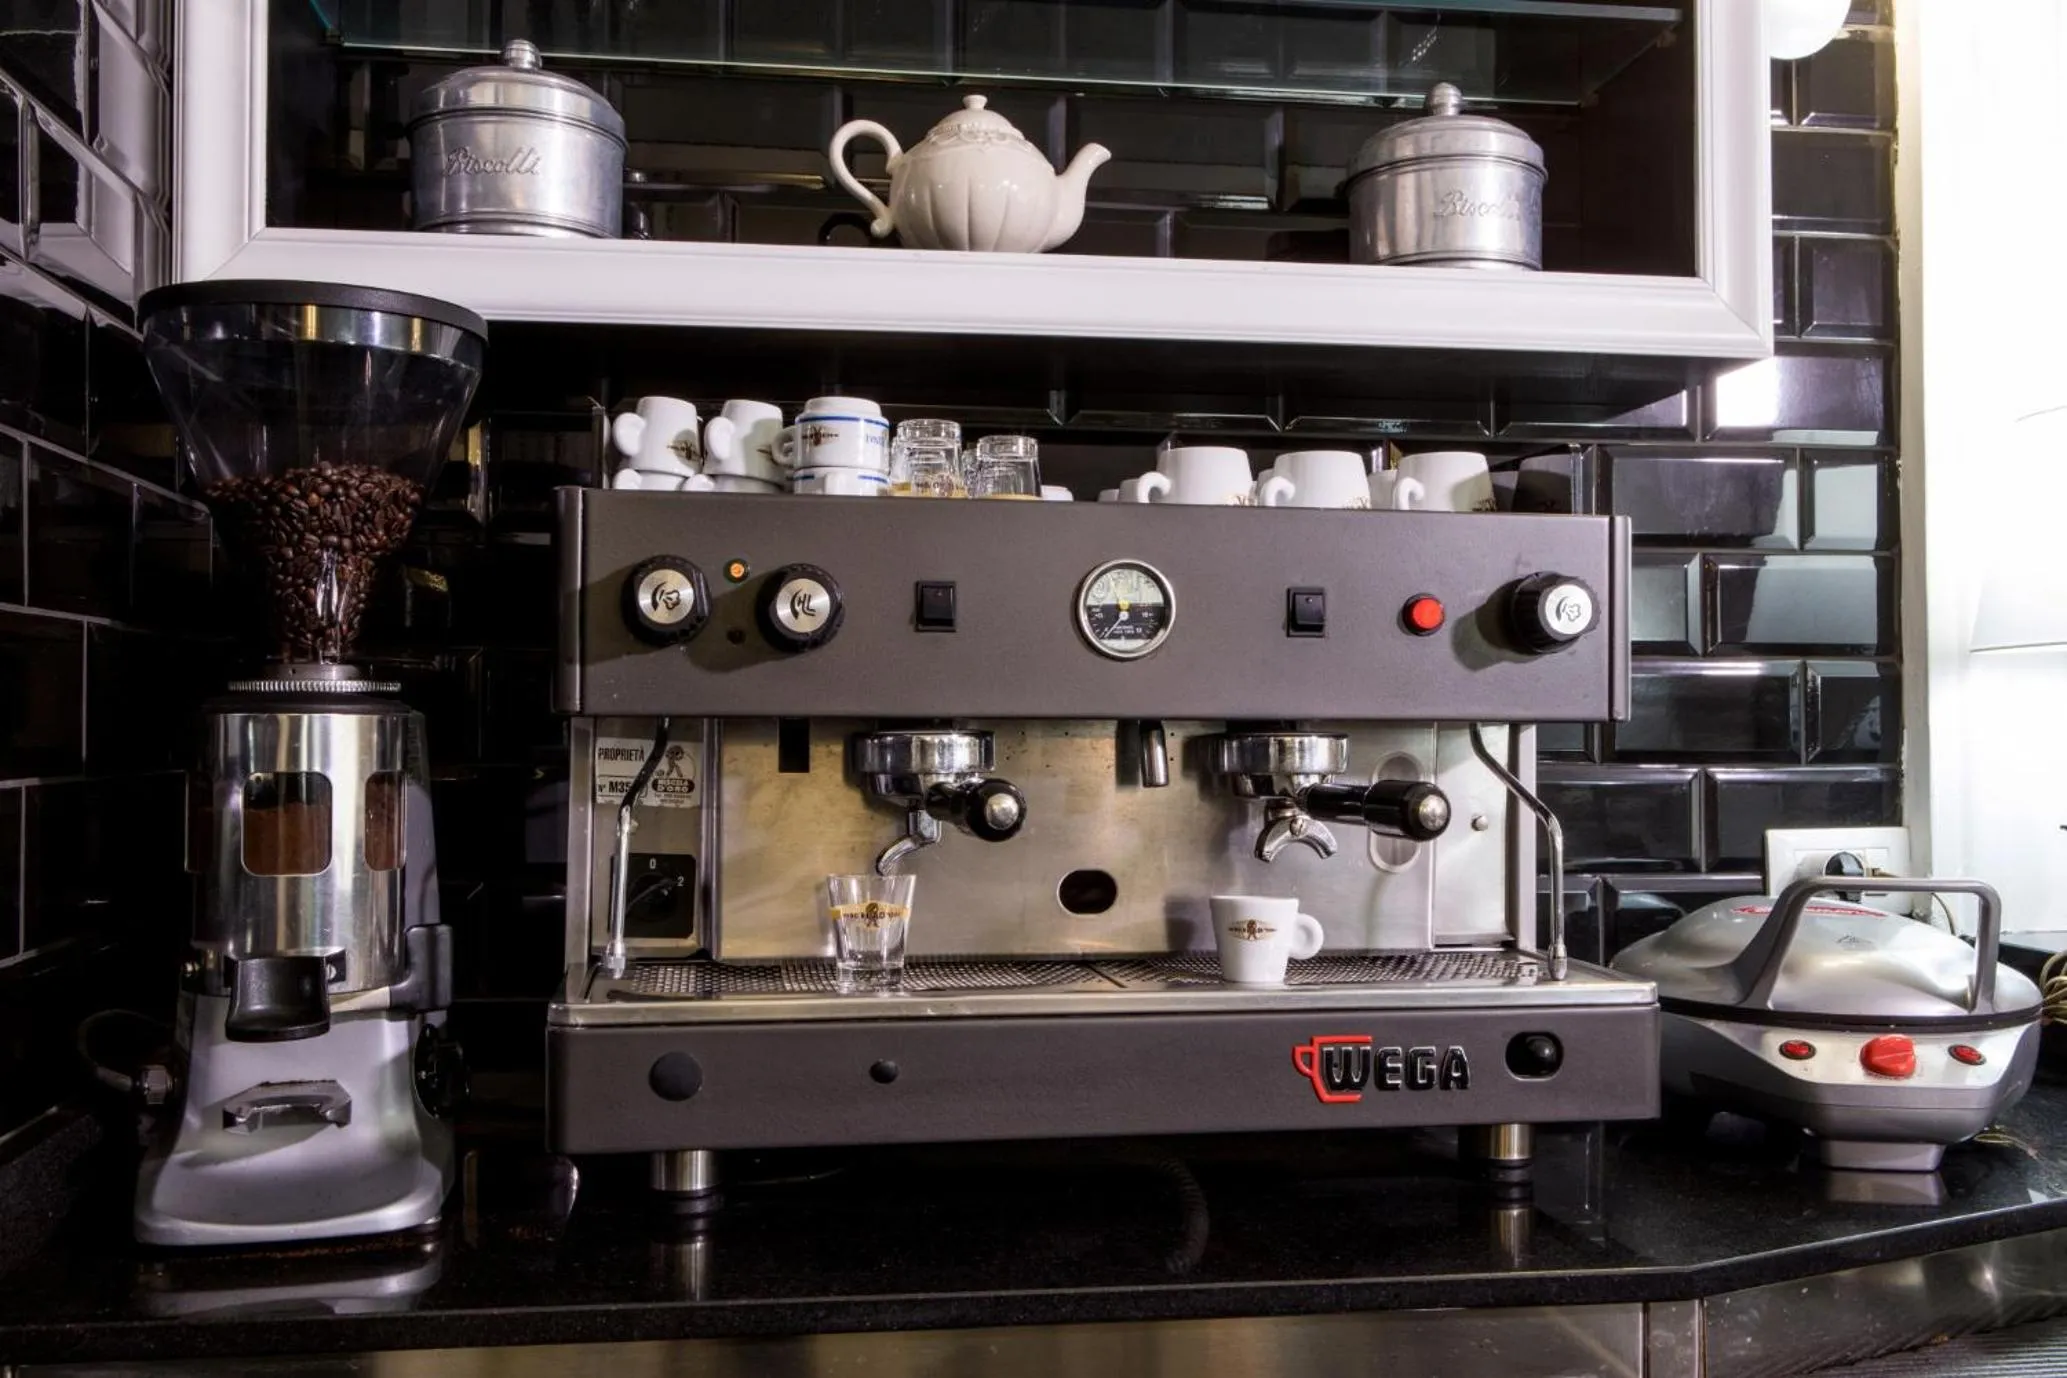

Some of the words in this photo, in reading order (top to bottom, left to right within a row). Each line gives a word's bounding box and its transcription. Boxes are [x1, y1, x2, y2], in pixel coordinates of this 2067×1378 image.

[1433, 188, 1522, 221] Bisco
[598, 745, 645, 761] PROPRIETÀ
[677, 876, 685, 887] 2
[1322, 1045, 1471, 1091] WEGA
